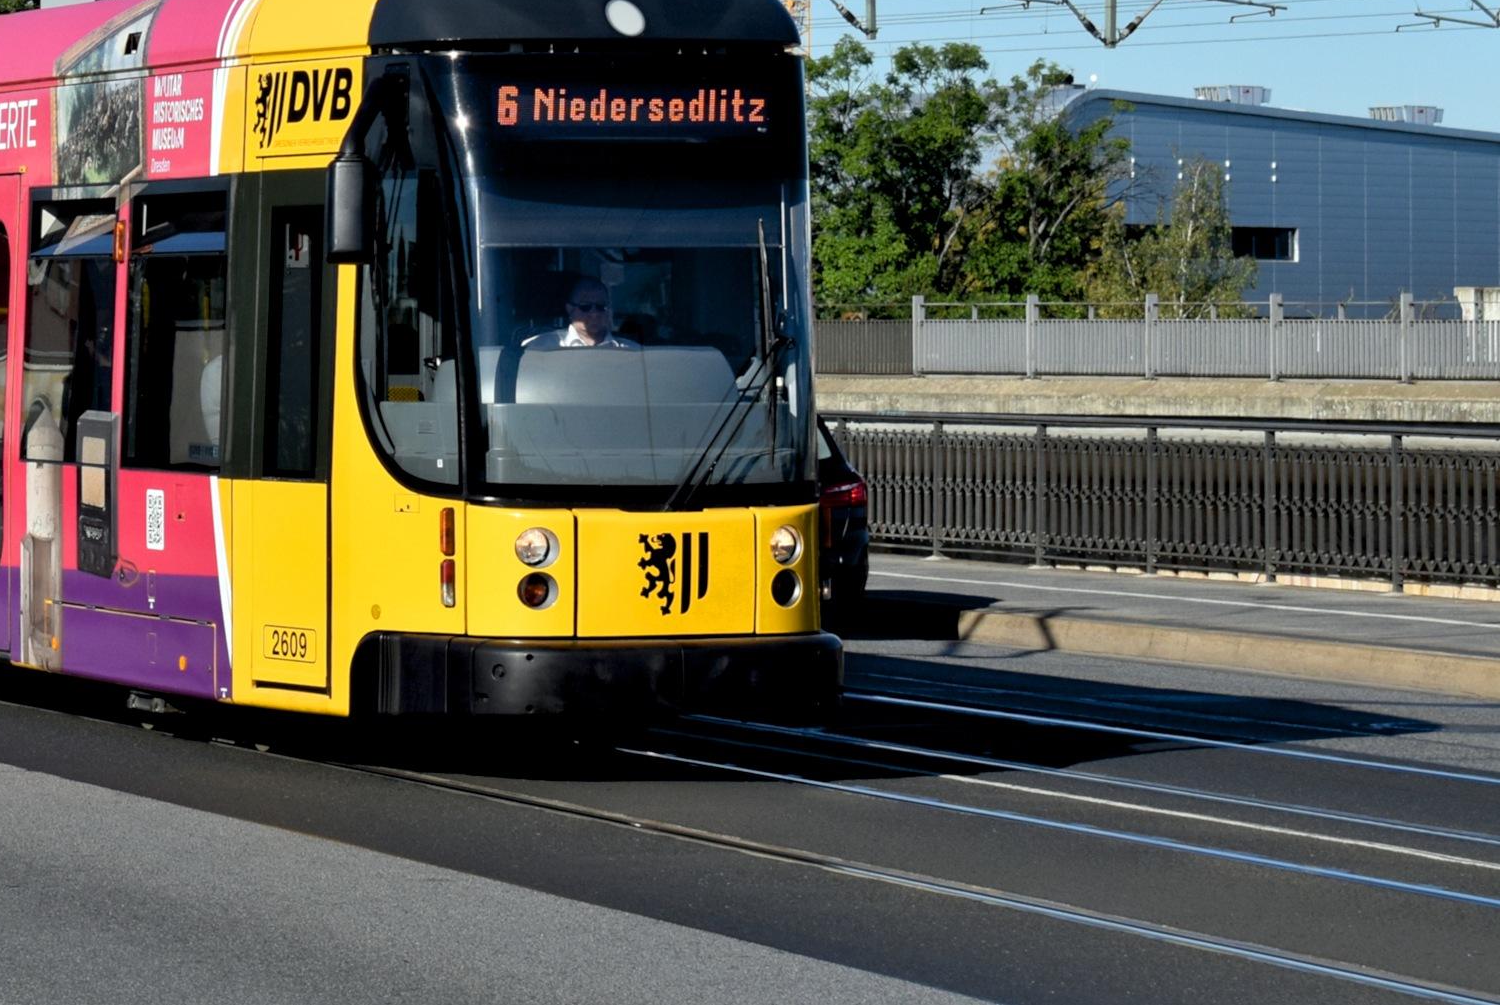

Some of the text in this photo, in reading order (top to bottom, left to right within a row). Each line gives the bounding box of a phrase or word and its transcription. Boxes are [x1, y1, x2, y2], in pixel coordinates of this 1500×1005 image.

[286, 67, 353, 123] DVB
[497, 86, 765, 125] 6 Niedersedlitz
[153, 98, 204, 124] HISTORISCHES
[152, 127, 185, 150] MUSEUM
[150, 158, 171, 173] Dresden
[272, 630, 307, 658] 2609
